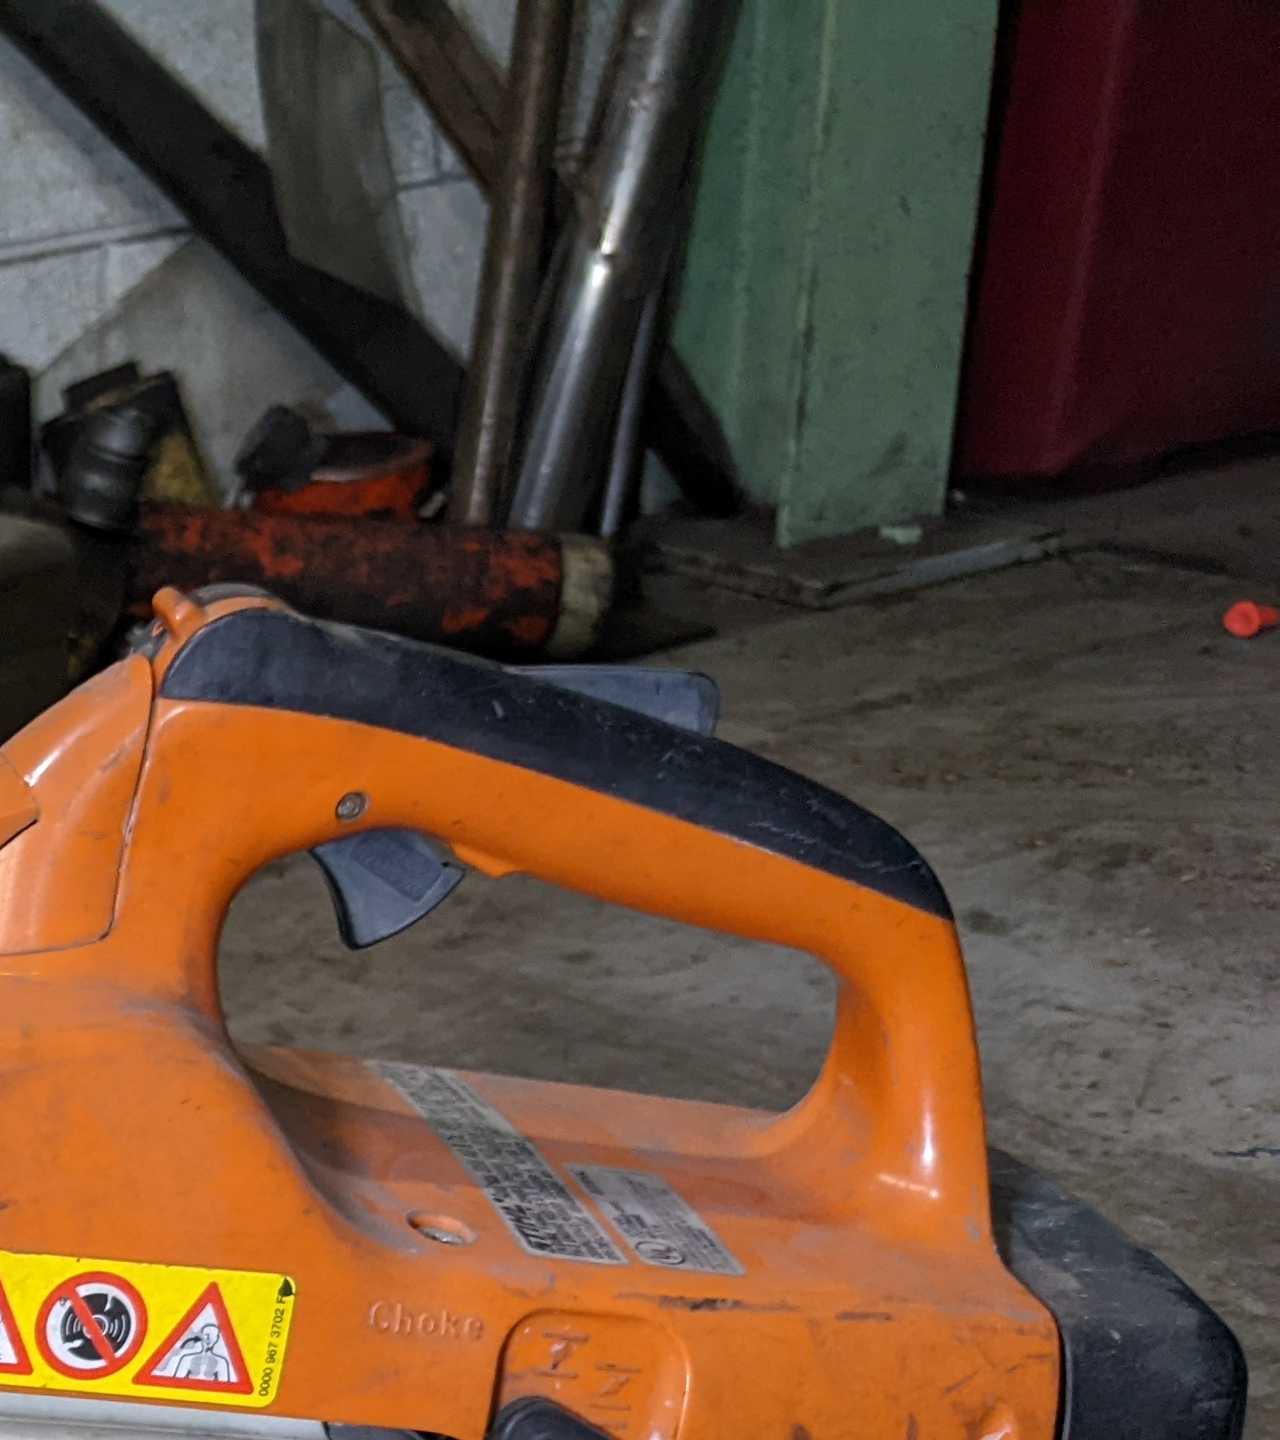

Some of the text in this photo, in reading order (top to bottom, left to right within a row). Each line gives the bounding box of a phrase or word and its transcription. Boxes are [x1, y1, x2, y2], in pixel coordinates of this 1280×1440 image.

[270, 1308, 286, 1338] 3702
[368, 1300, 485, 1340] Choke
[265, 1341, 278, 1364] 967
[258, 1367, 274, 1397] 0000
